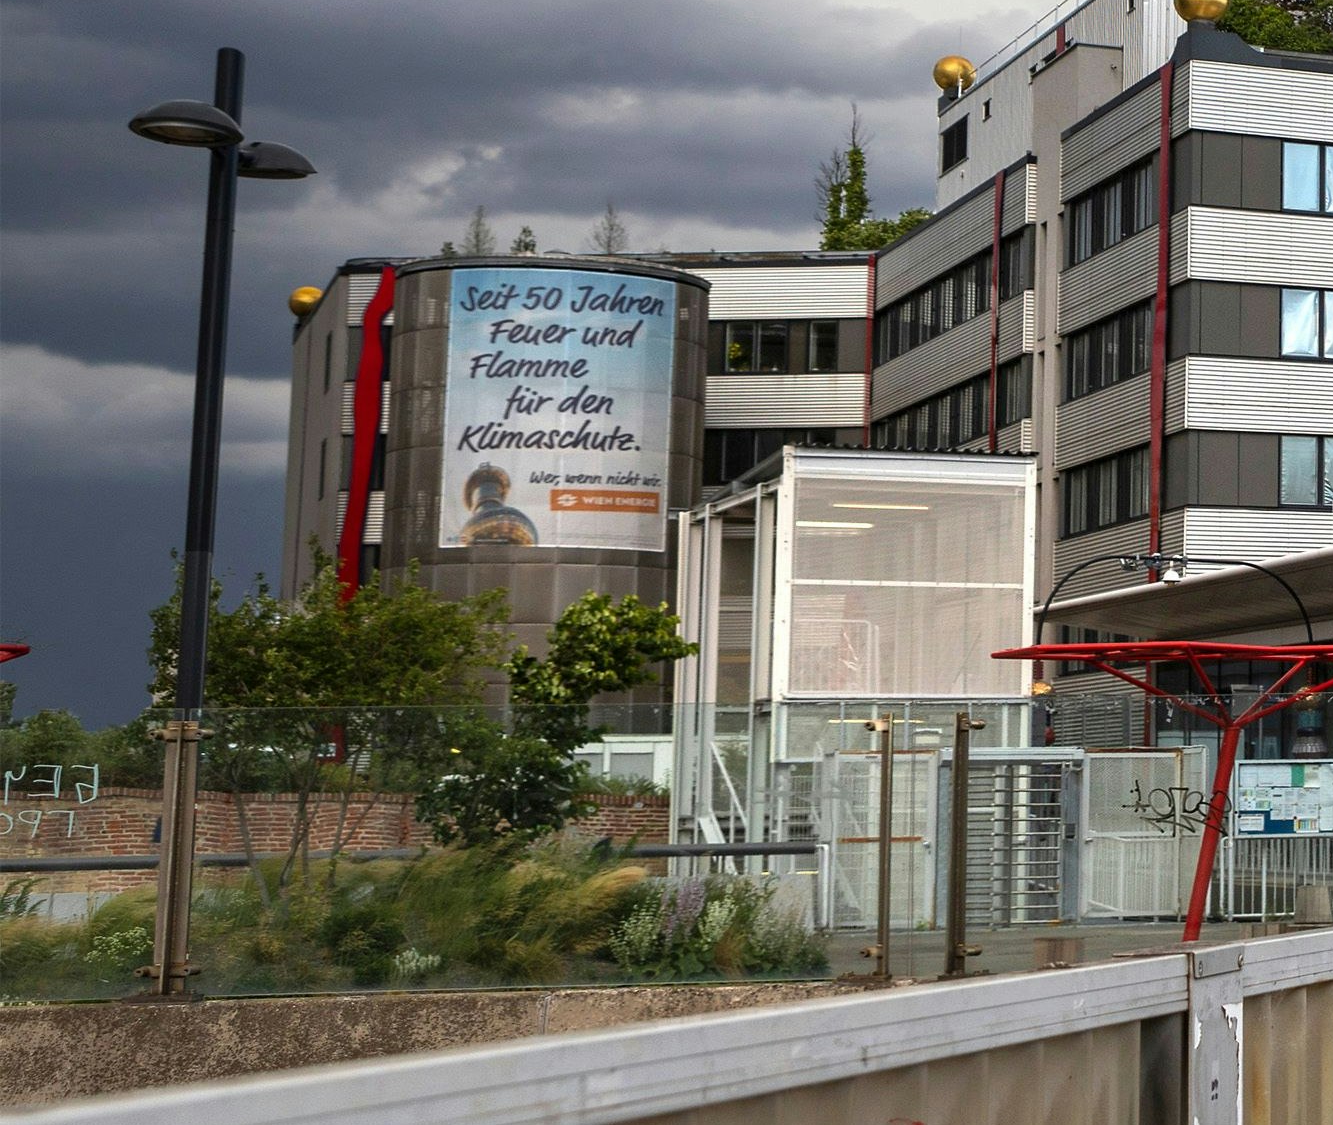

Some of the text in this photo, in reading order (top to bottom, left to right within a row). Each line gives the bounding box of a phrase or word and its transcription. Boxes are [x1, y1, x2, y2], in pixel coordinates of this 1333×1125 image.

[460, 283, 664, 317] Seit 50 Jahren
[490, 319, 643, 348] Feuer und
[470, 352, 589, 379] Flamme
[503, 385, 614, 419] für den
[457, 420, 641, 452] Klimaschutz.
[529, 471, 560, 486] Wer,
[565, 474, 602, 485] wenn
[606, 471, 641, 485] nicht
[583, 496, 614, 505] WIEN
